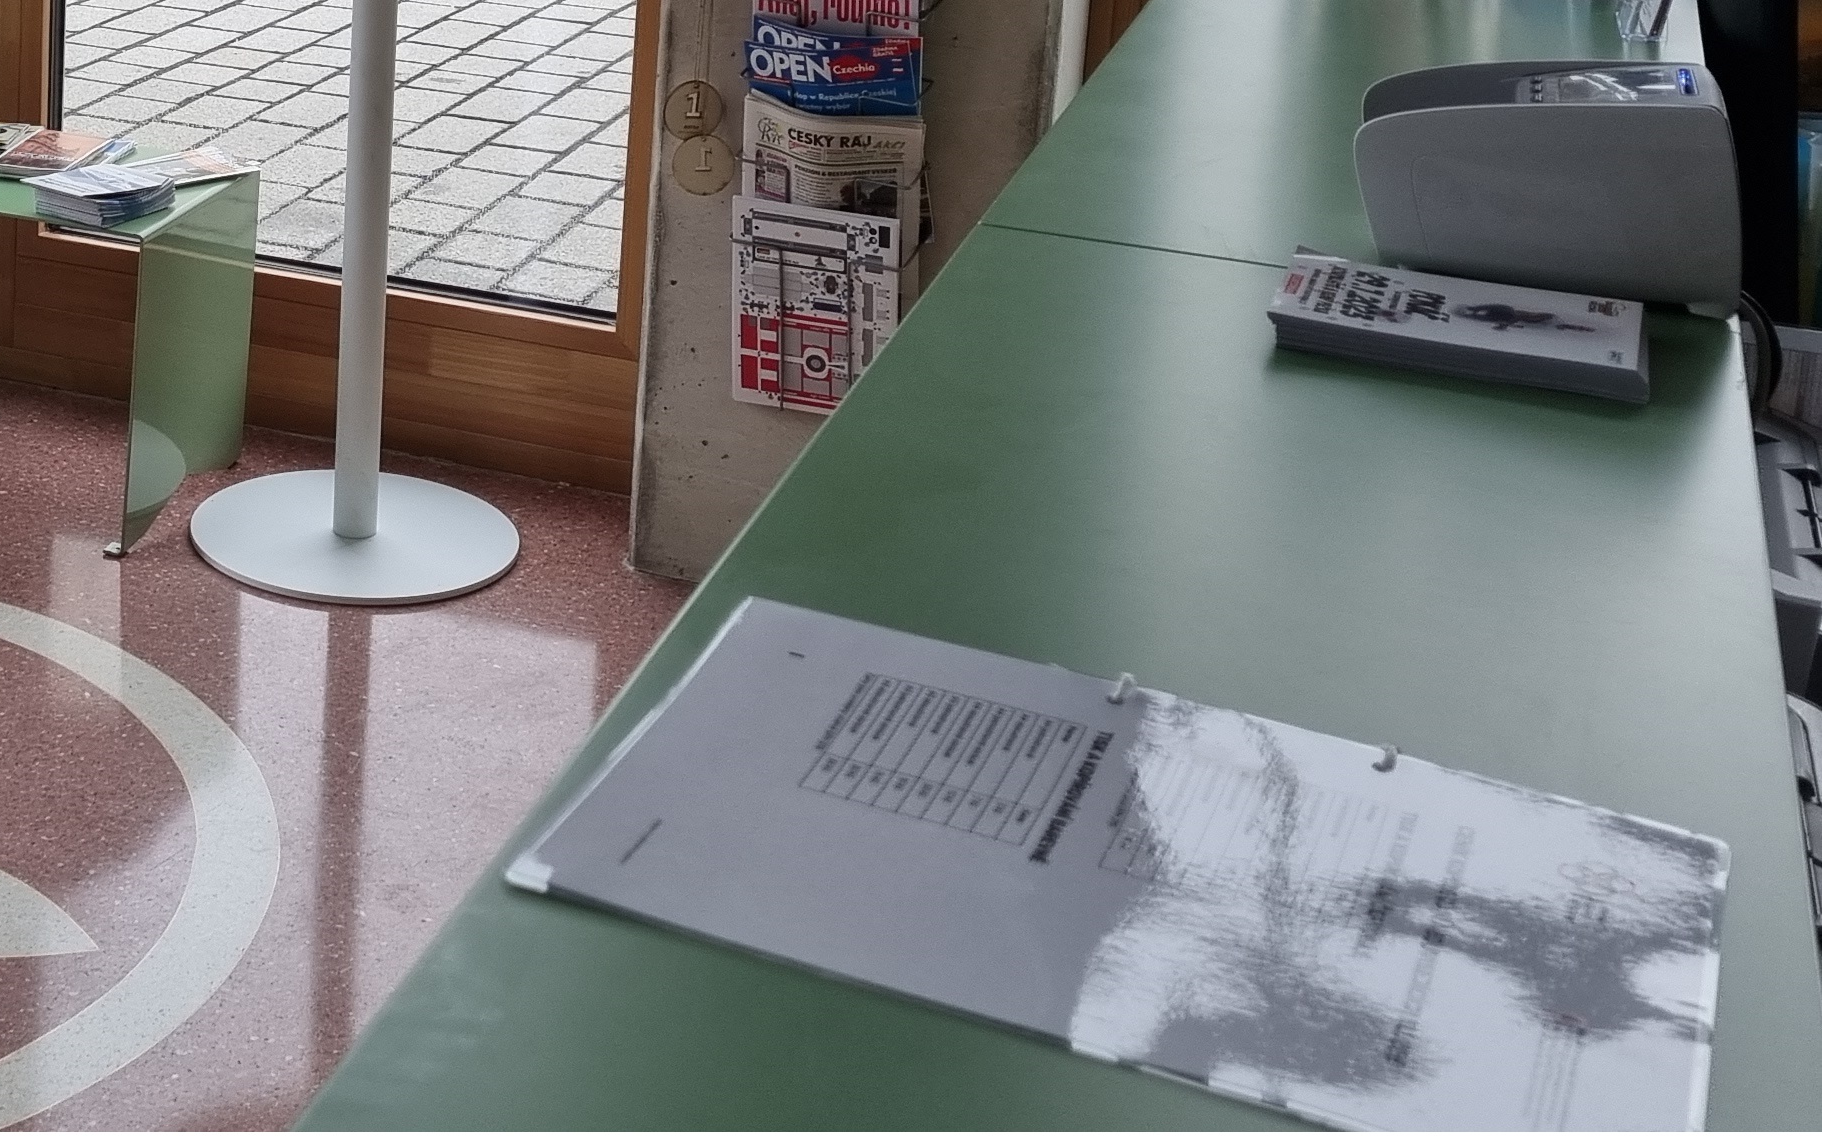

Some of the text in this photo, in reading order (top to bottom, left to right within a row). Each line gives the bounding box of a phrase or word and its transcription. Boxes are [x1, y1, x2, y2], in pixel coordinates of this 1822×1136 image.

[749, 48, 834, 83] OPEN
[833, 62, 876, 75] Czechia
[685, 92, 701, 118] 1
[818, 92, 859, 102] Republice
[839, 133, 872, 148] RÁJ
[1087, 730, 1115, 754] TISK
